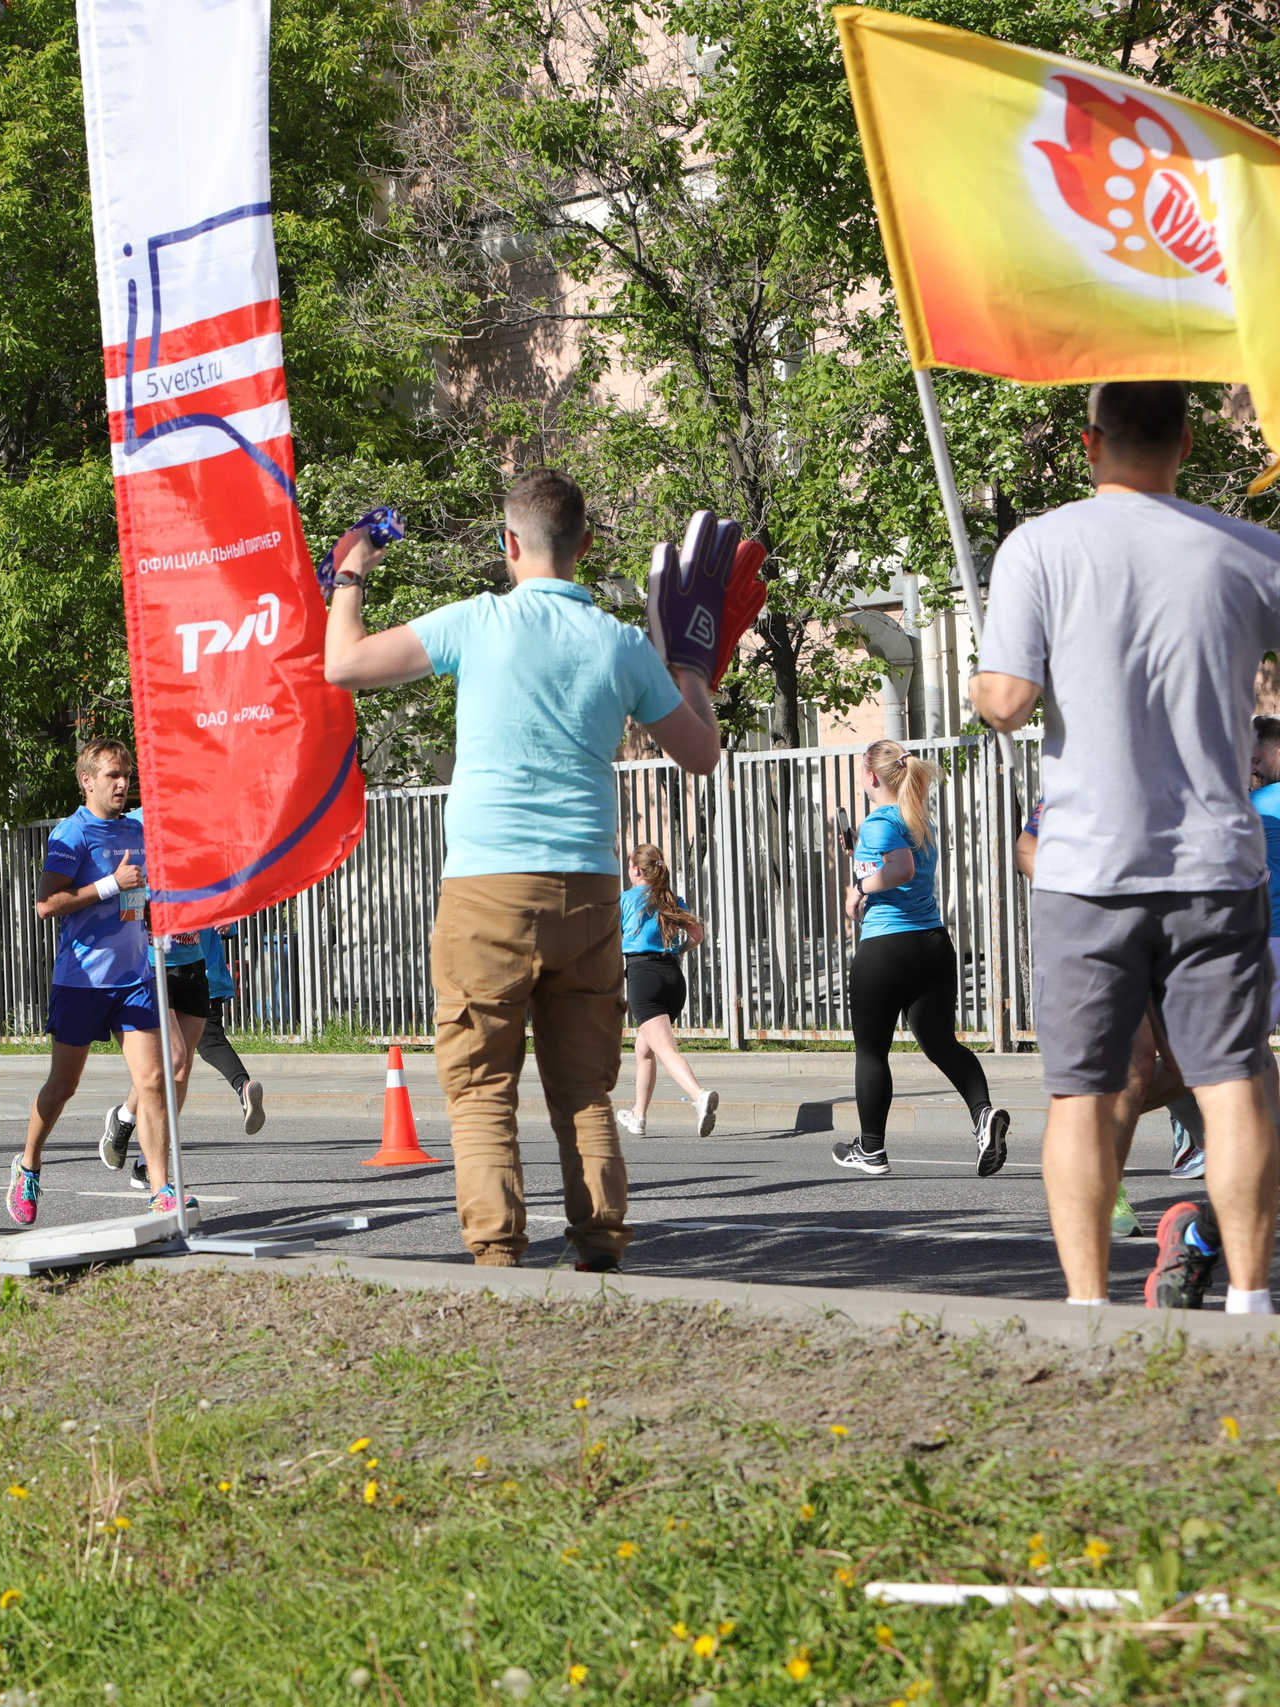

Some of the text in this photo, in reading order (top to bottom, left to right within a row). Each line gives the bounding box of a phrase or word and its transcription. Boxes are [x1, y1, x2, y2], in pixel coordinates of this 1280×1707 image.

[146, 361, 223, 398] 5verst.ru
[138, 531, 282, 574] ОФИЦИАЛЬНЫЙ ПАРТНЕР
[197, 704, 275, 728] ОАО «РЖД»
